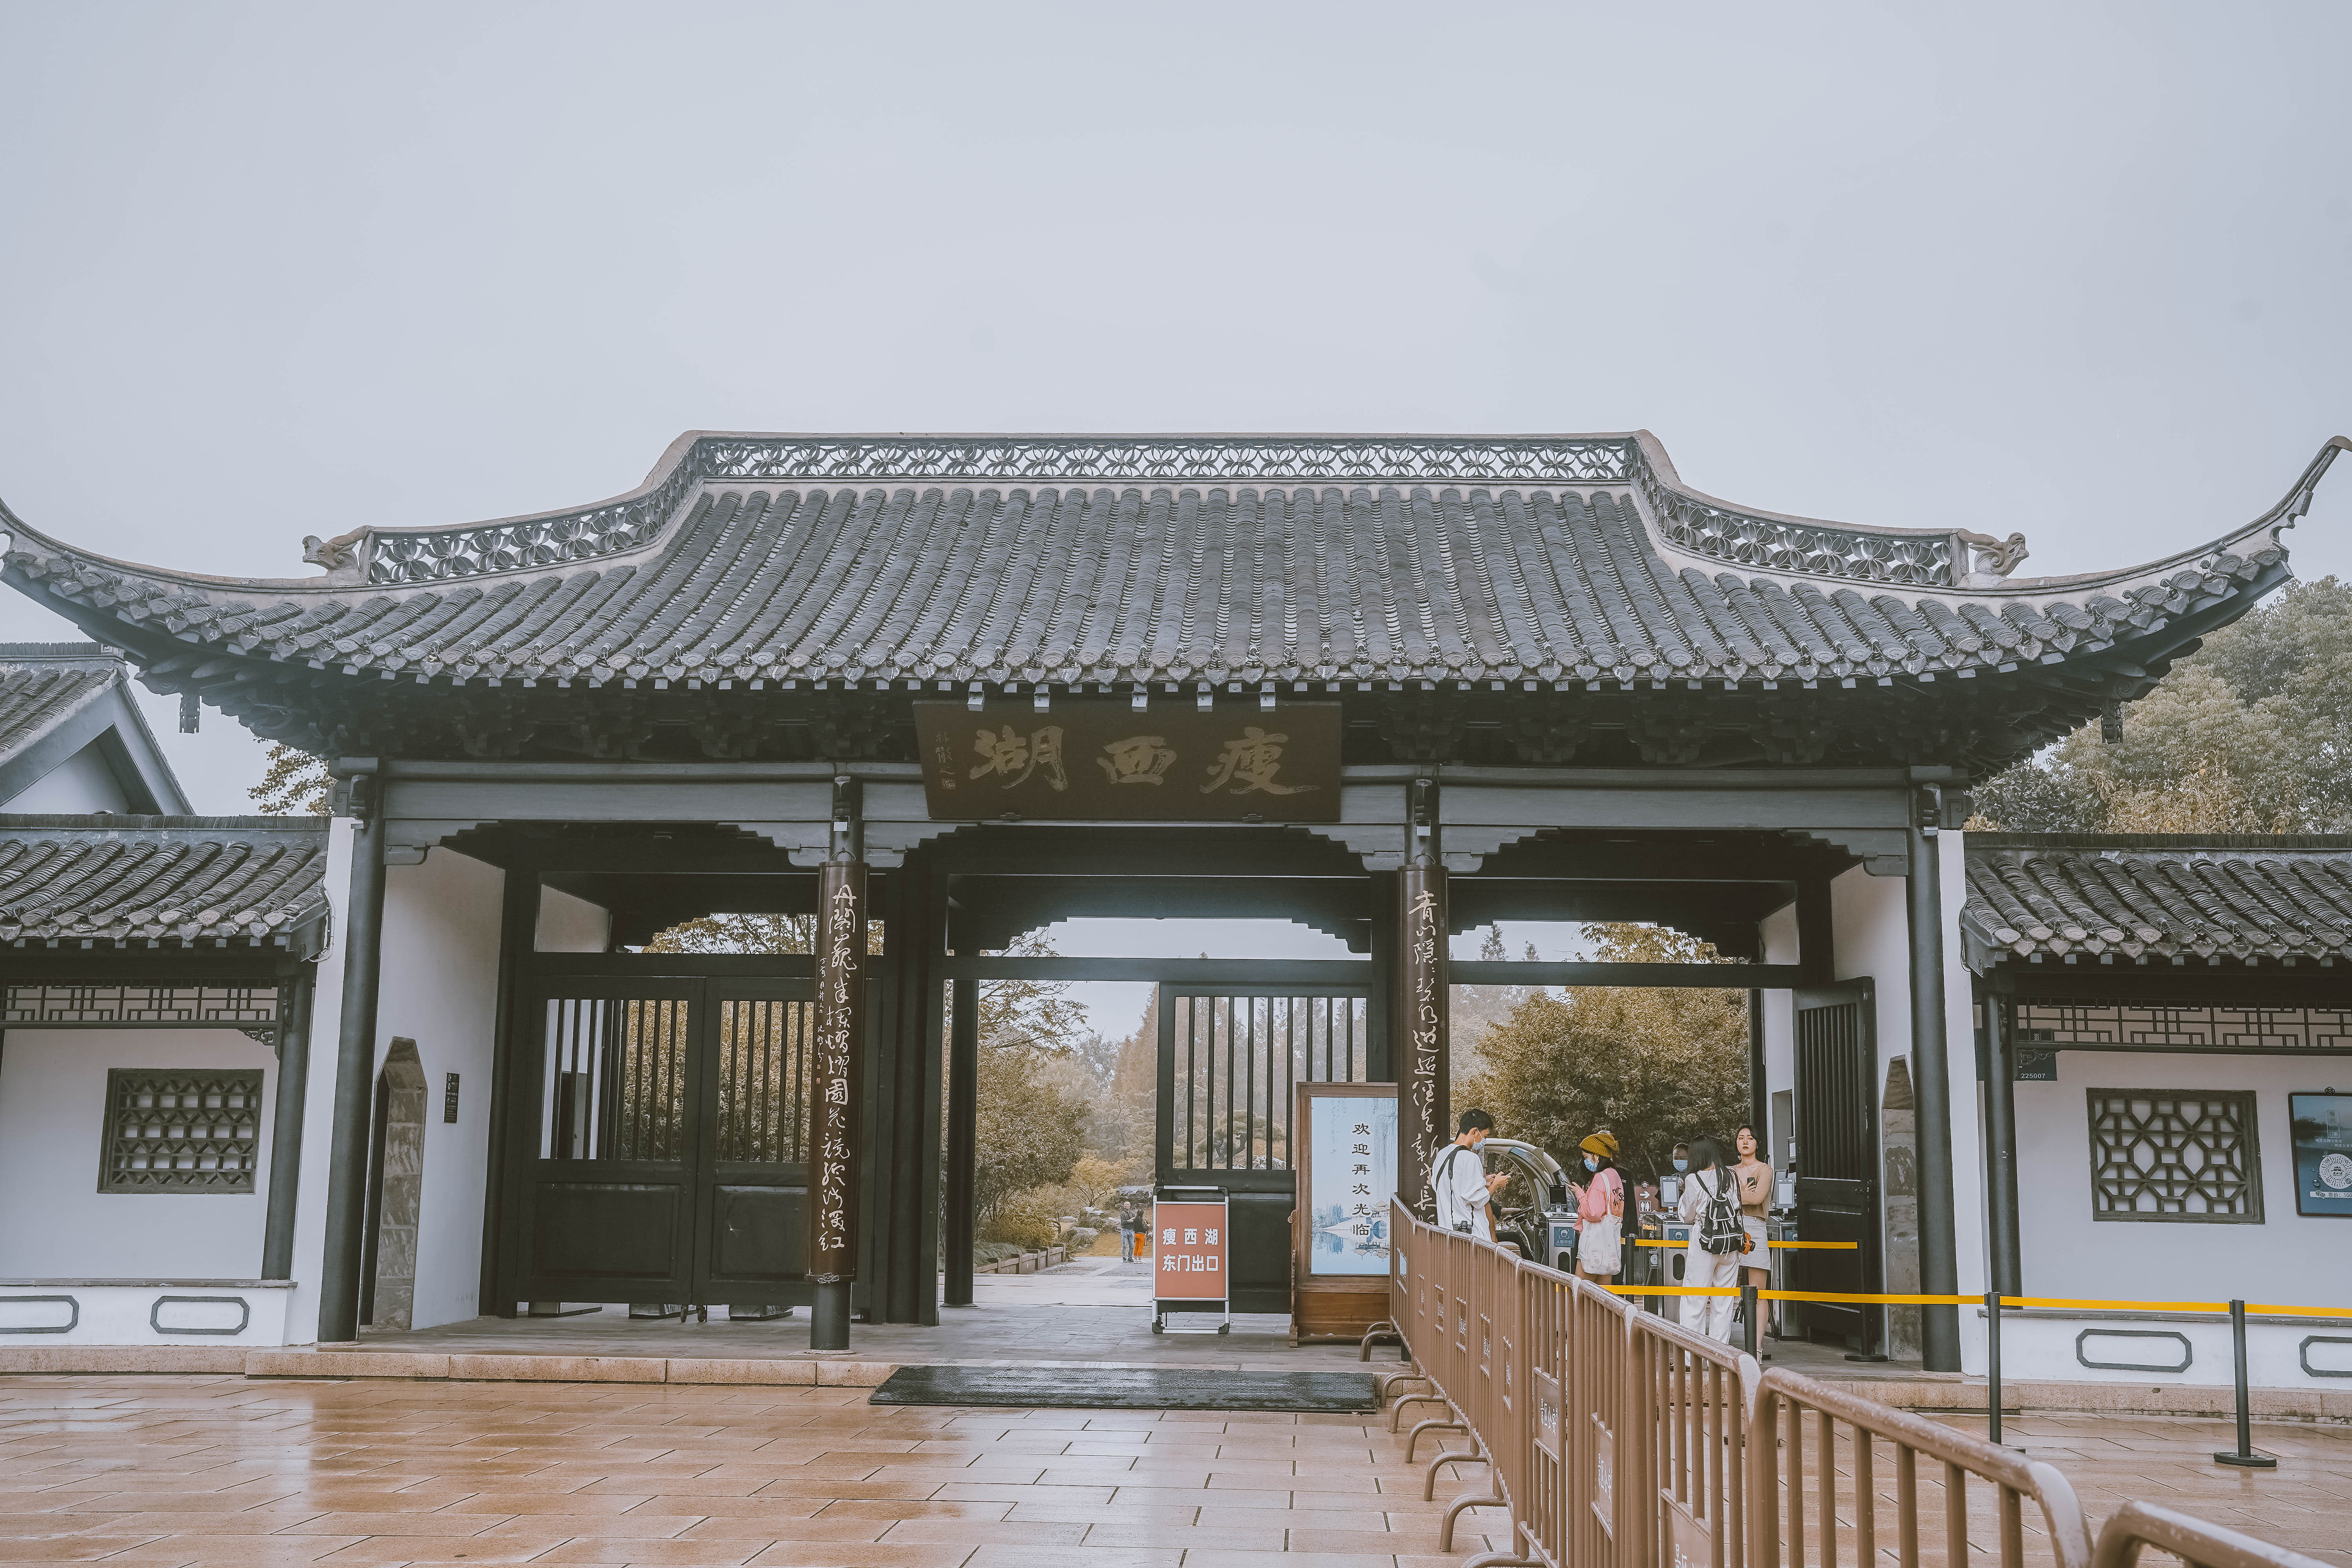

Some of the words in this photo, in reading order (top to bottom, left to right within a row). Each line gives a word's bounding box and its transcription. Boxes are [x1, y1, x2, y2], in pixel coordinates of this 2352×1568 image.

[1351, 1123, 1371, 1236] 欢迎再次光临
[1162, 1228, 1218, 1246] 瘦西湖
[1162, 1254, 1218, 1272] 东门出口
